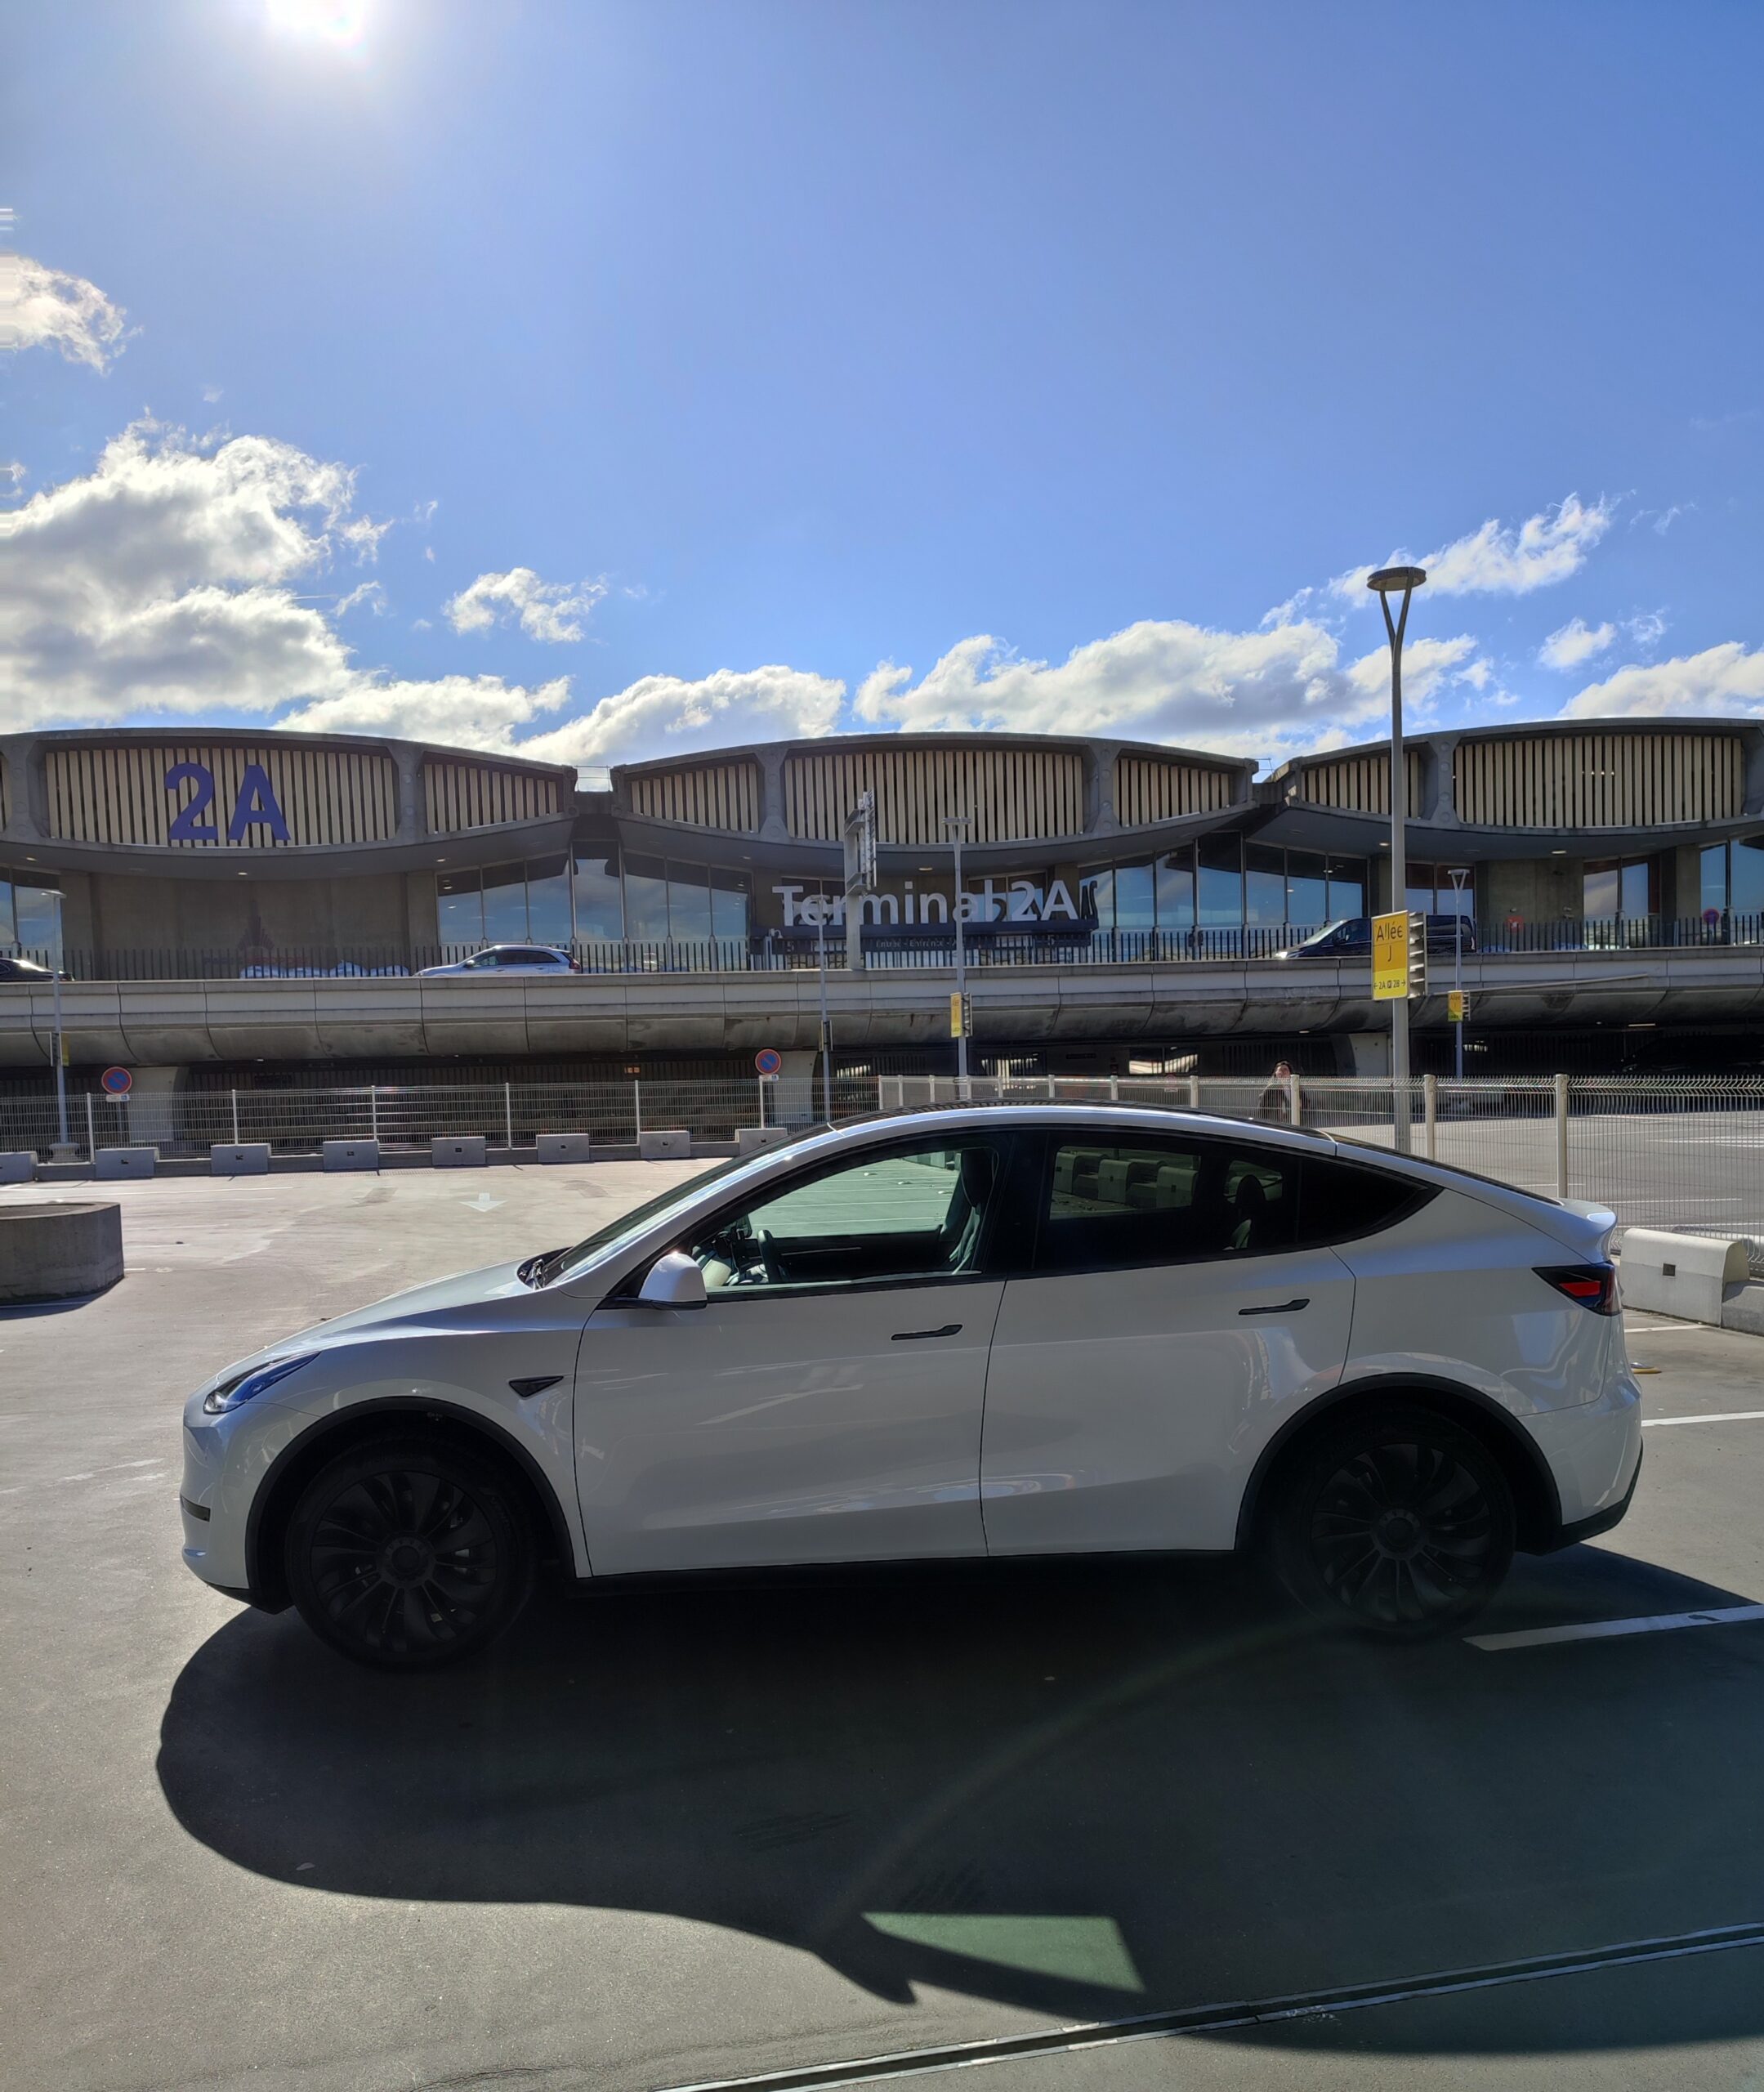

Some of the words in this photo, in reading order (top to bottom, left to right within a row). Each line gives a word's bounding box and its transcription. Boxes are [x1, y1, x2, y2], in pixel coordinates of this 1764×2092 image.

[165, 762, 291, 840] 2A
[772, 879, 994, 927] Terminal
[1011, 880, 1079, 922] 2A
[1376, 920, 1404, 941] Allée
[1387, 945, 1392, 962] J
